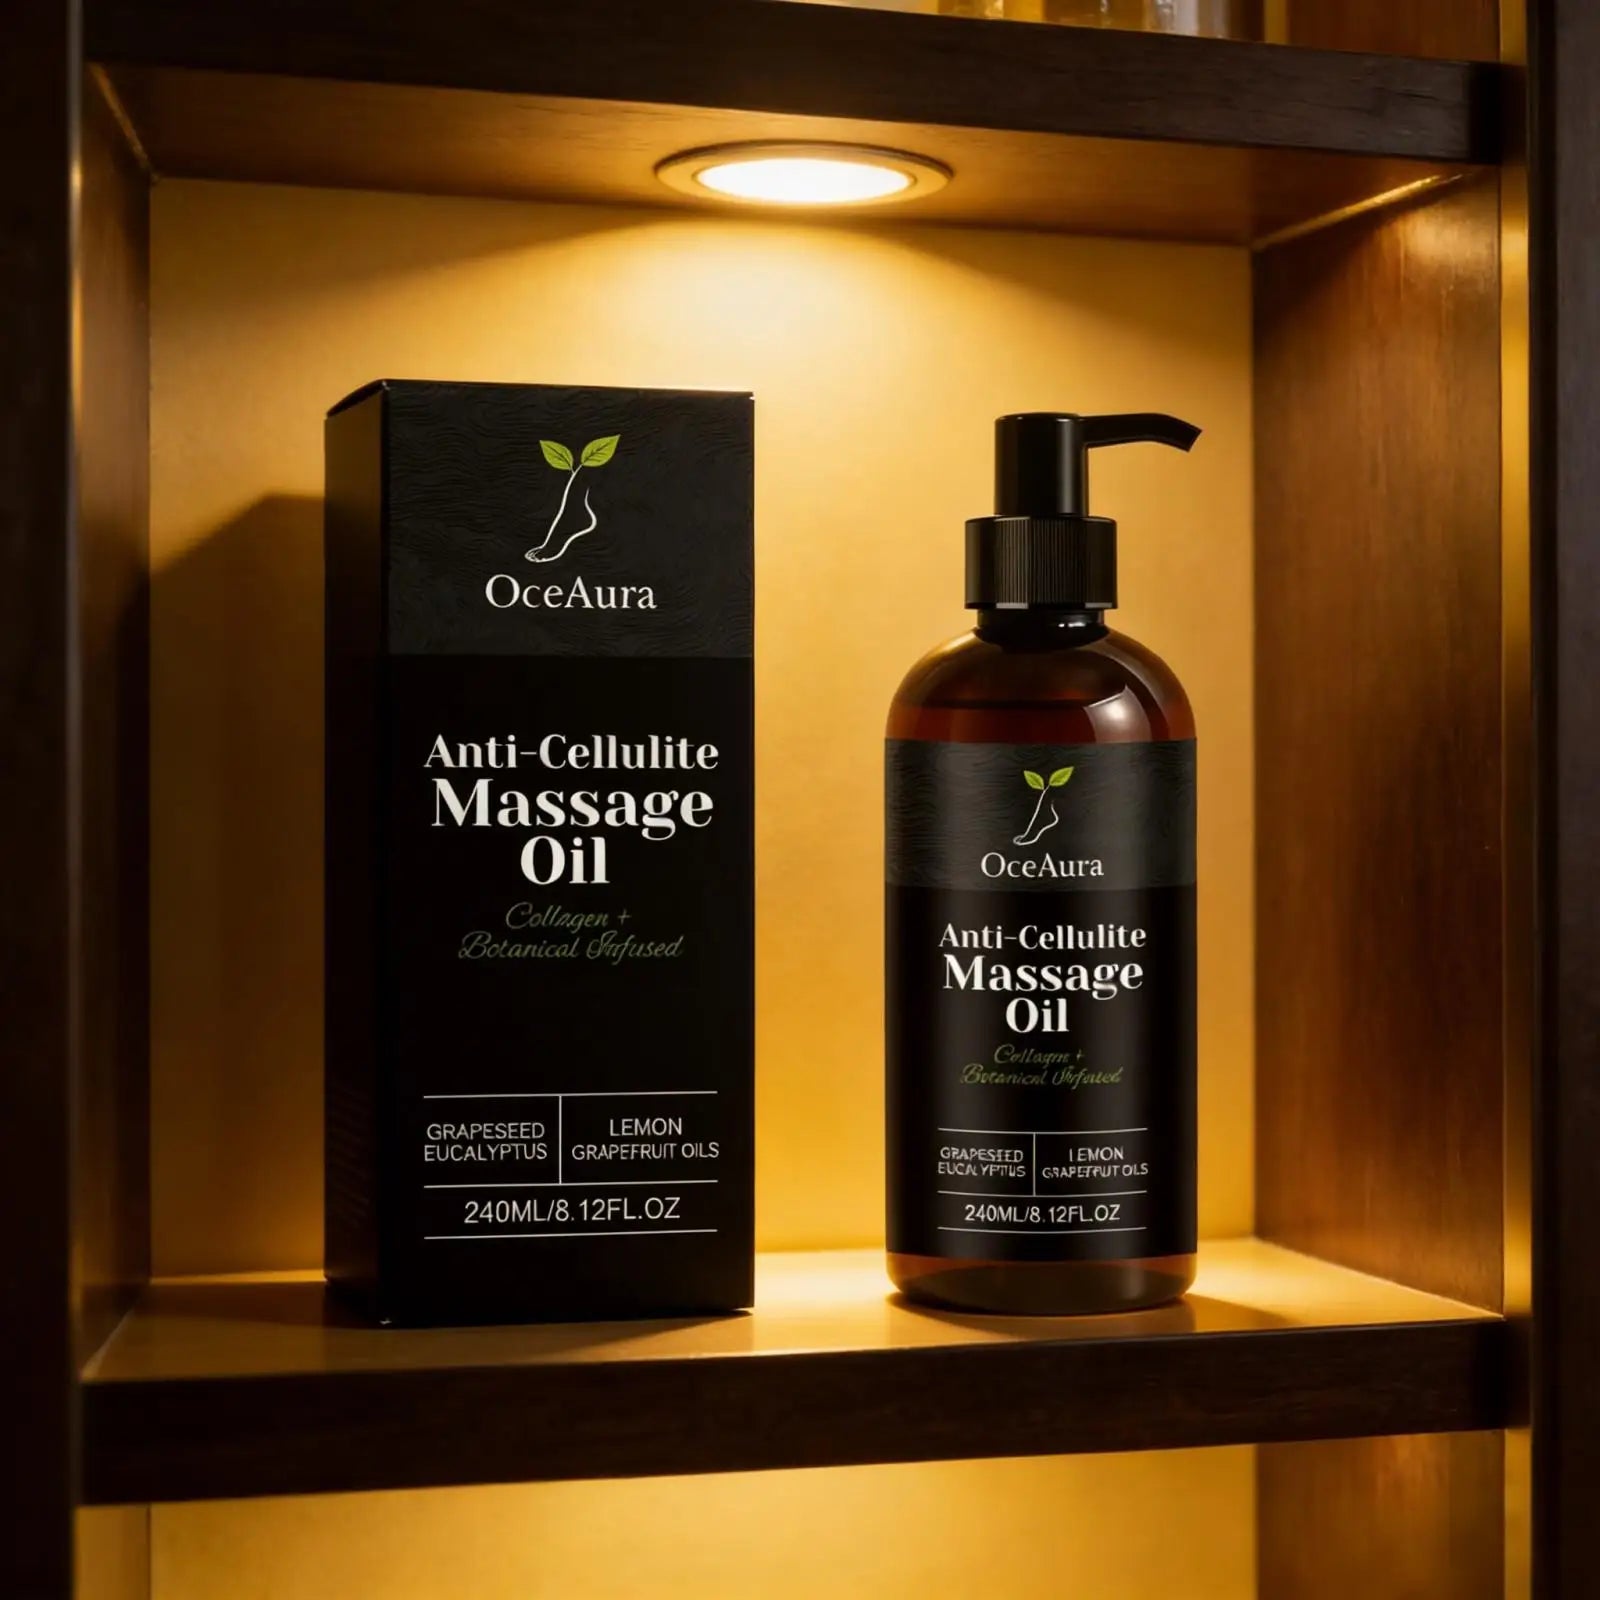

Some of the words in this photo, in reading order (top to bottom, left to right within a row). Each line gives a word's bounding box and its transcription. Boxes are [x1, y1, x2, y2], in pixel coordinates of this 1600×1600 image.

[485, 573, 657, 610] OceAura
[424, 734, 719, 770] Anti-Cellulite
[432, 778, 713, 841] Massage
[520, 836, 610, 885] Oil
[981, 852, 1104, 878] OceAura
[506, 902, 609, 934] Collagen
[458, 930, 580, 959] Botanical
[586, 930, 684, 965] Infused
[938, 922, 1147, 950] Anti-Cellulite
[943, 953, 1143, 1001] Massage
[1006, 997, 1069, 1033] Oil
[426, 1122, 545, 1141] GRAPESEED
[610, 1117, 682, 1137] LEMON
[424, 1142, 548, 1162] EUCALYPTUS
[572, 1143, 677, 1161] GRAPEFRUIT
[681, 1141, 720, 1159] OILS
